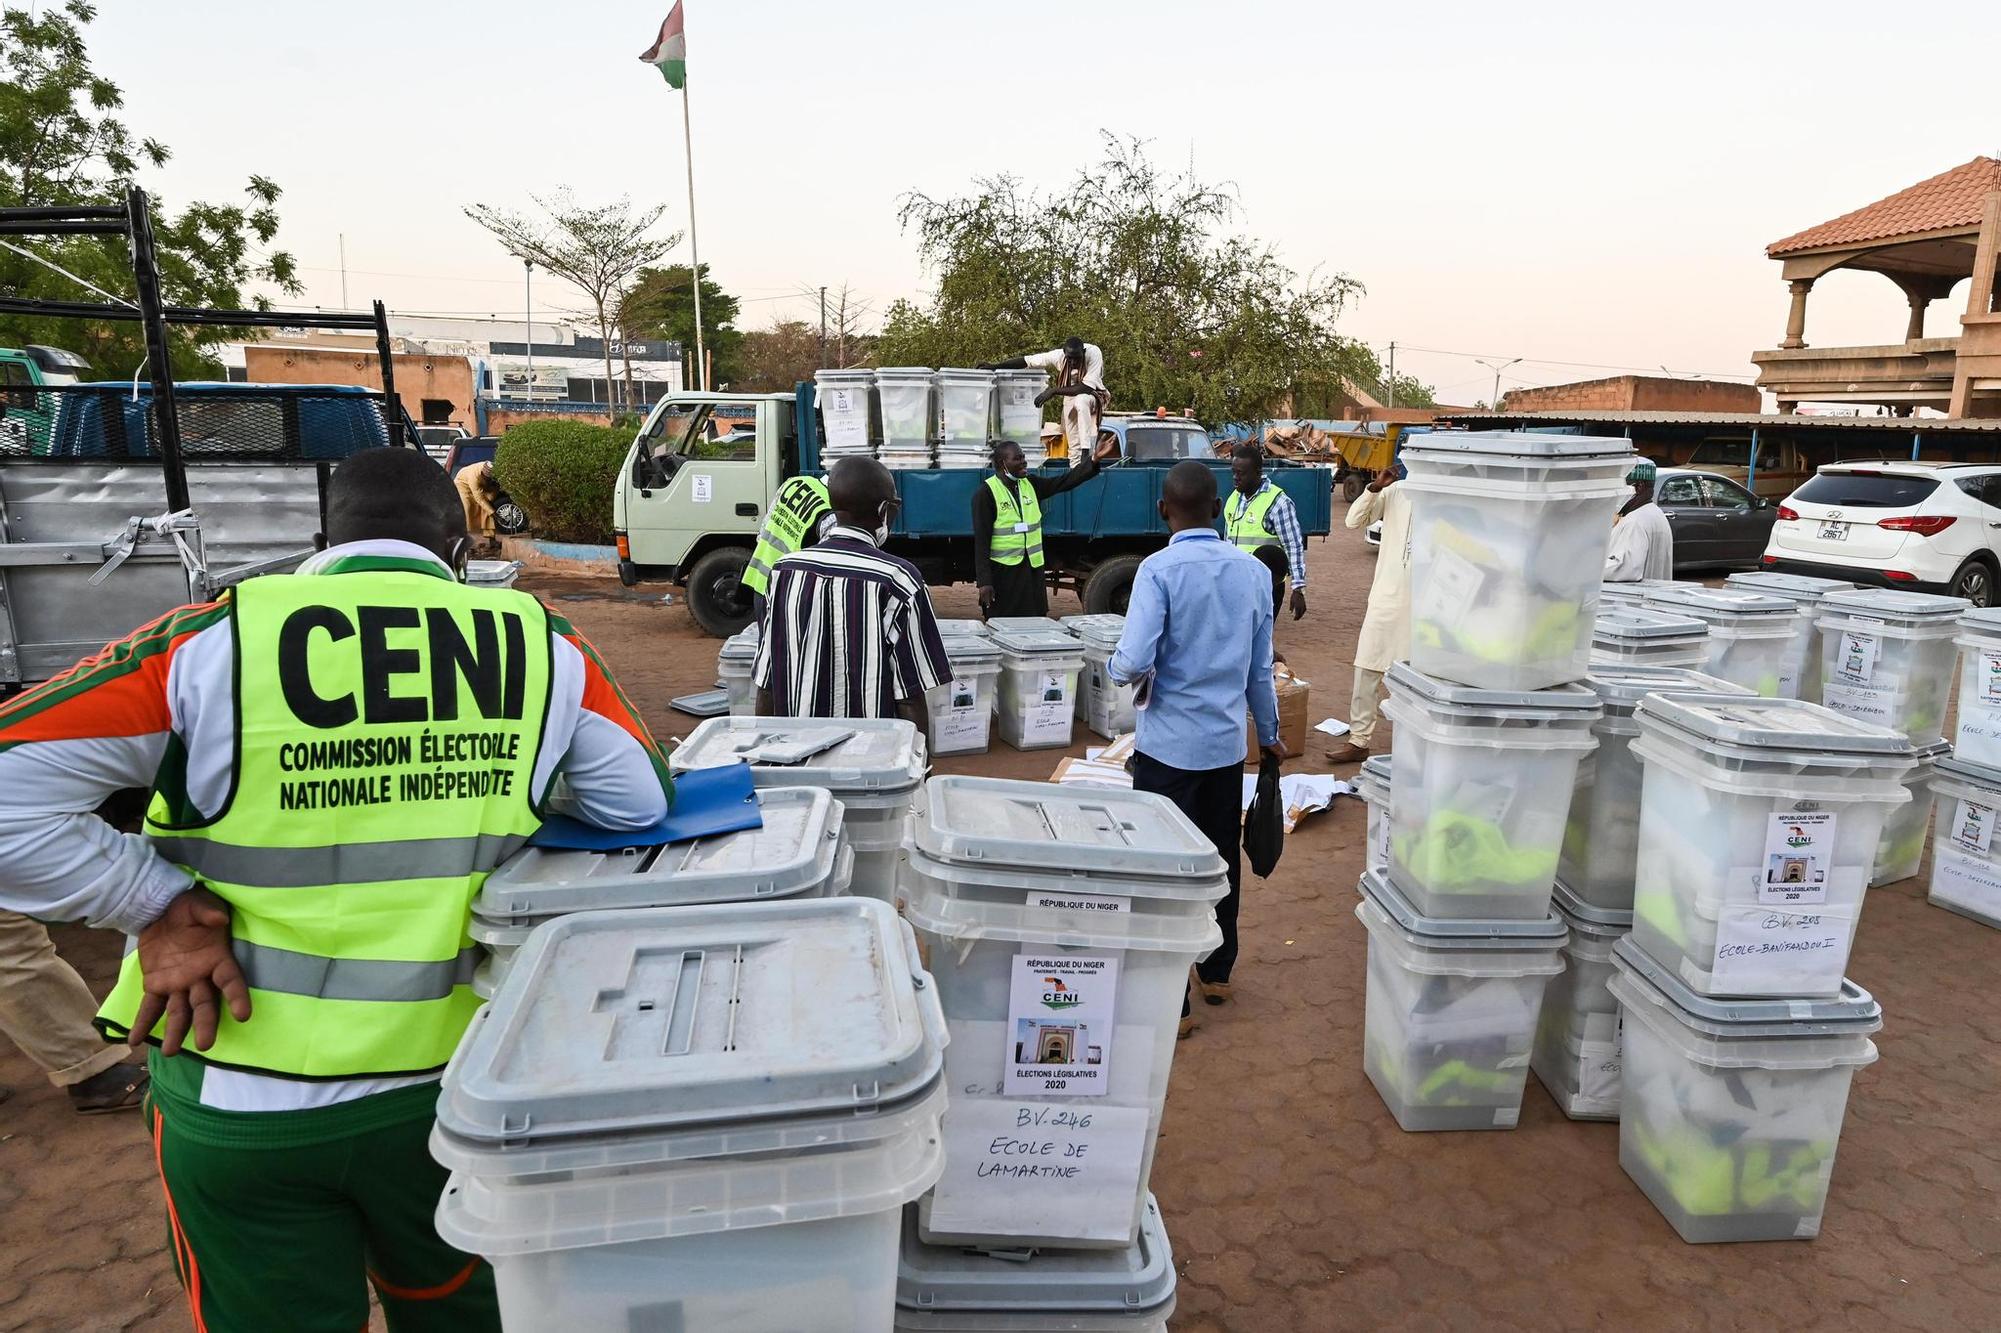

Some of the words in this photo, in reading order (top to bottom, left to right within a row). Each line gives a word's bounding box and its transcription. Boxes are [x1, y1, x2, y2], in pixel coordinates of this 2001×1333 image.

[780, 479, 825, 524] CENI
[278, 604, 526, 729] CENI
[280, 736, 411, 771] COMMISSION
[420, 728, 520, 763] ÉLECTORLE
[280, 775, 392, 810] NATIONALE
[1039, 898, 1084, 909] RÉPUBLIQUE
[1085, 901, 1096, 910] DU
[1097, 903, 1119, 911] NIGER
[1026, 959, 1070, 968] RÉPUBLIQUE
[1043, 993, 1078, 1002] CENI
[1016, 1069, 1052, 1078] ÉLECTIONS
[1053, 1068, 1098, 1078] LÉGISLATIVES
[1044, 1080, 1066, 1089] 2020
[989, 1137, 1055, 1155] ECOLE
[1063, 1142, 1088, 1158] DE
